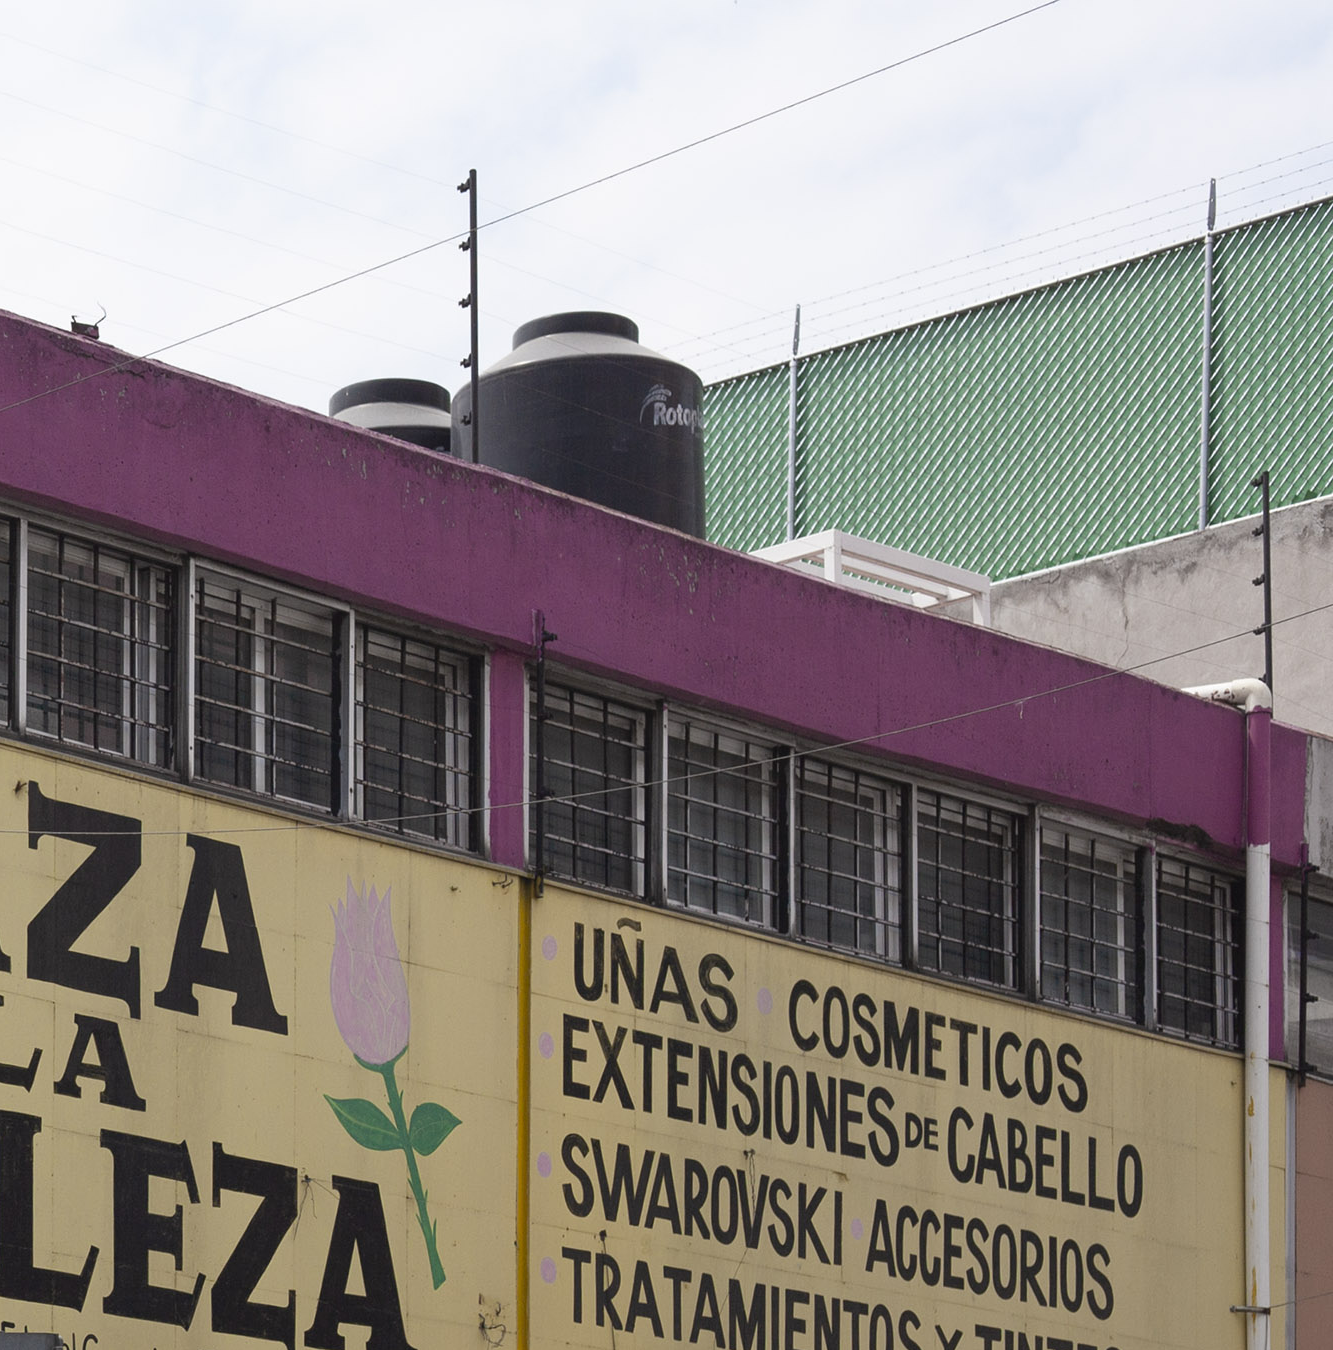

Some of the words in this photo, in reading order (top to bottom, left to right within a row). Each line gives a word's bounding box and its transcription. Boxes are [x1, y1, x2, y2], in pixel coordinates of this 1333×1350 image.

[653, 402, 703, 434] Rotopl
[574, 917, 738, 1032] UÑAS
[788, 979, 1088, 1114] COSMETICOS
[562, 1013, 900, 1167] EXTENSIONES
[905, 1111, 939, 1153] DE
[947, 1106, 1144, 1218] CABELLO
[561, 1132, 843, 1266] SWAROVSKI
[865, 1199, 1114, 1321] ACCESORIOS
